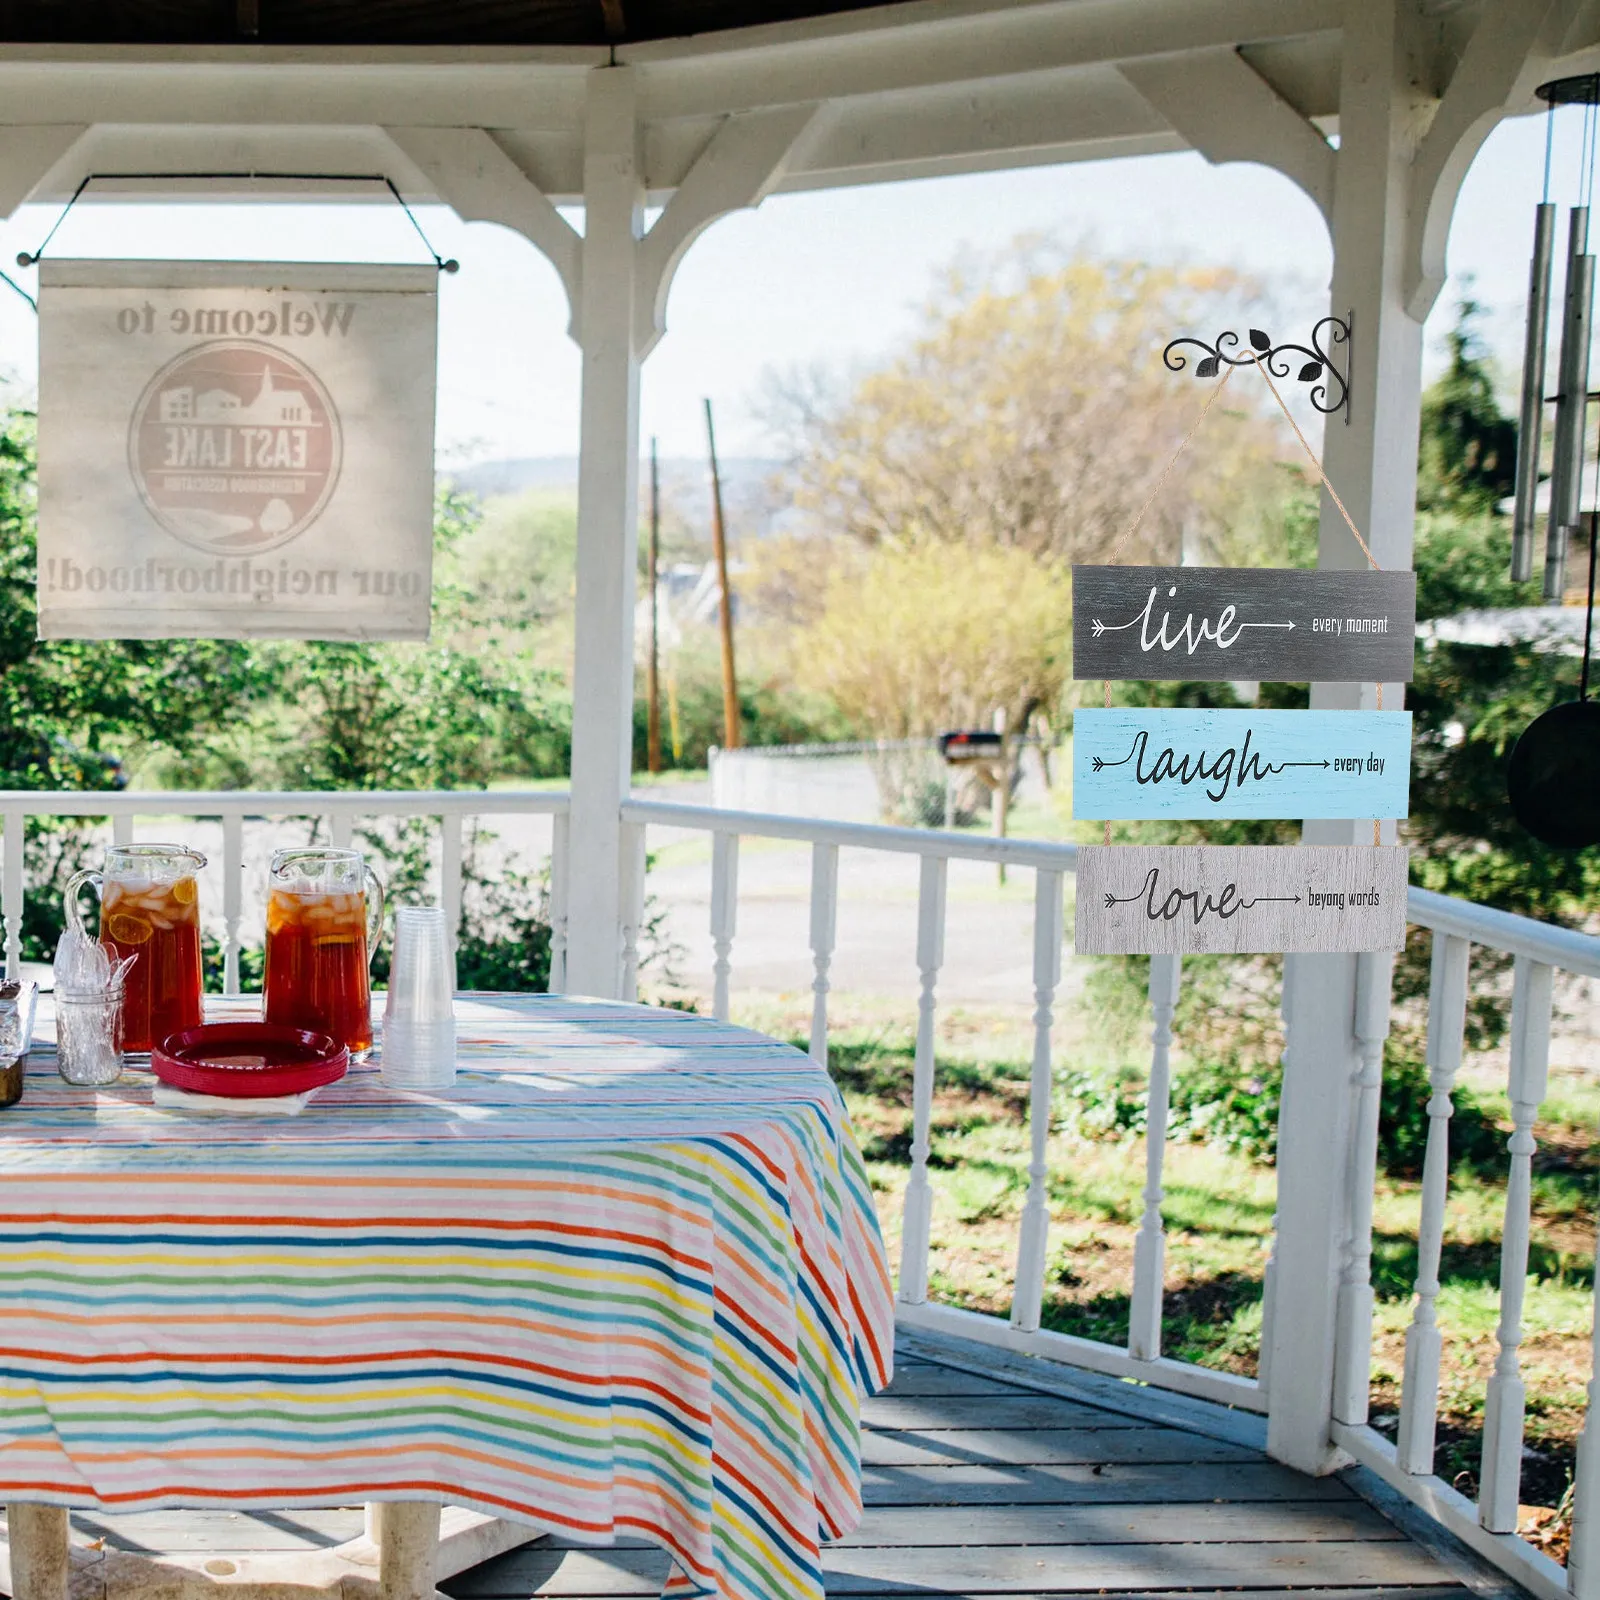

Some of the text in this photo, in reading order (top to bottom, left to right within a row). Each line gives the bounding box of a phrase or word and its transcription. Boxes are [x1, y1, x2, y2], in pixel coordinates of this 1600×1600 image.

[1140, 587, 1388, 655] live every moment
[1136, 729, 1385, 802] laugh every day
[1146, 868, 1243, 924] love
[1348, 887, 1379, 906] words
